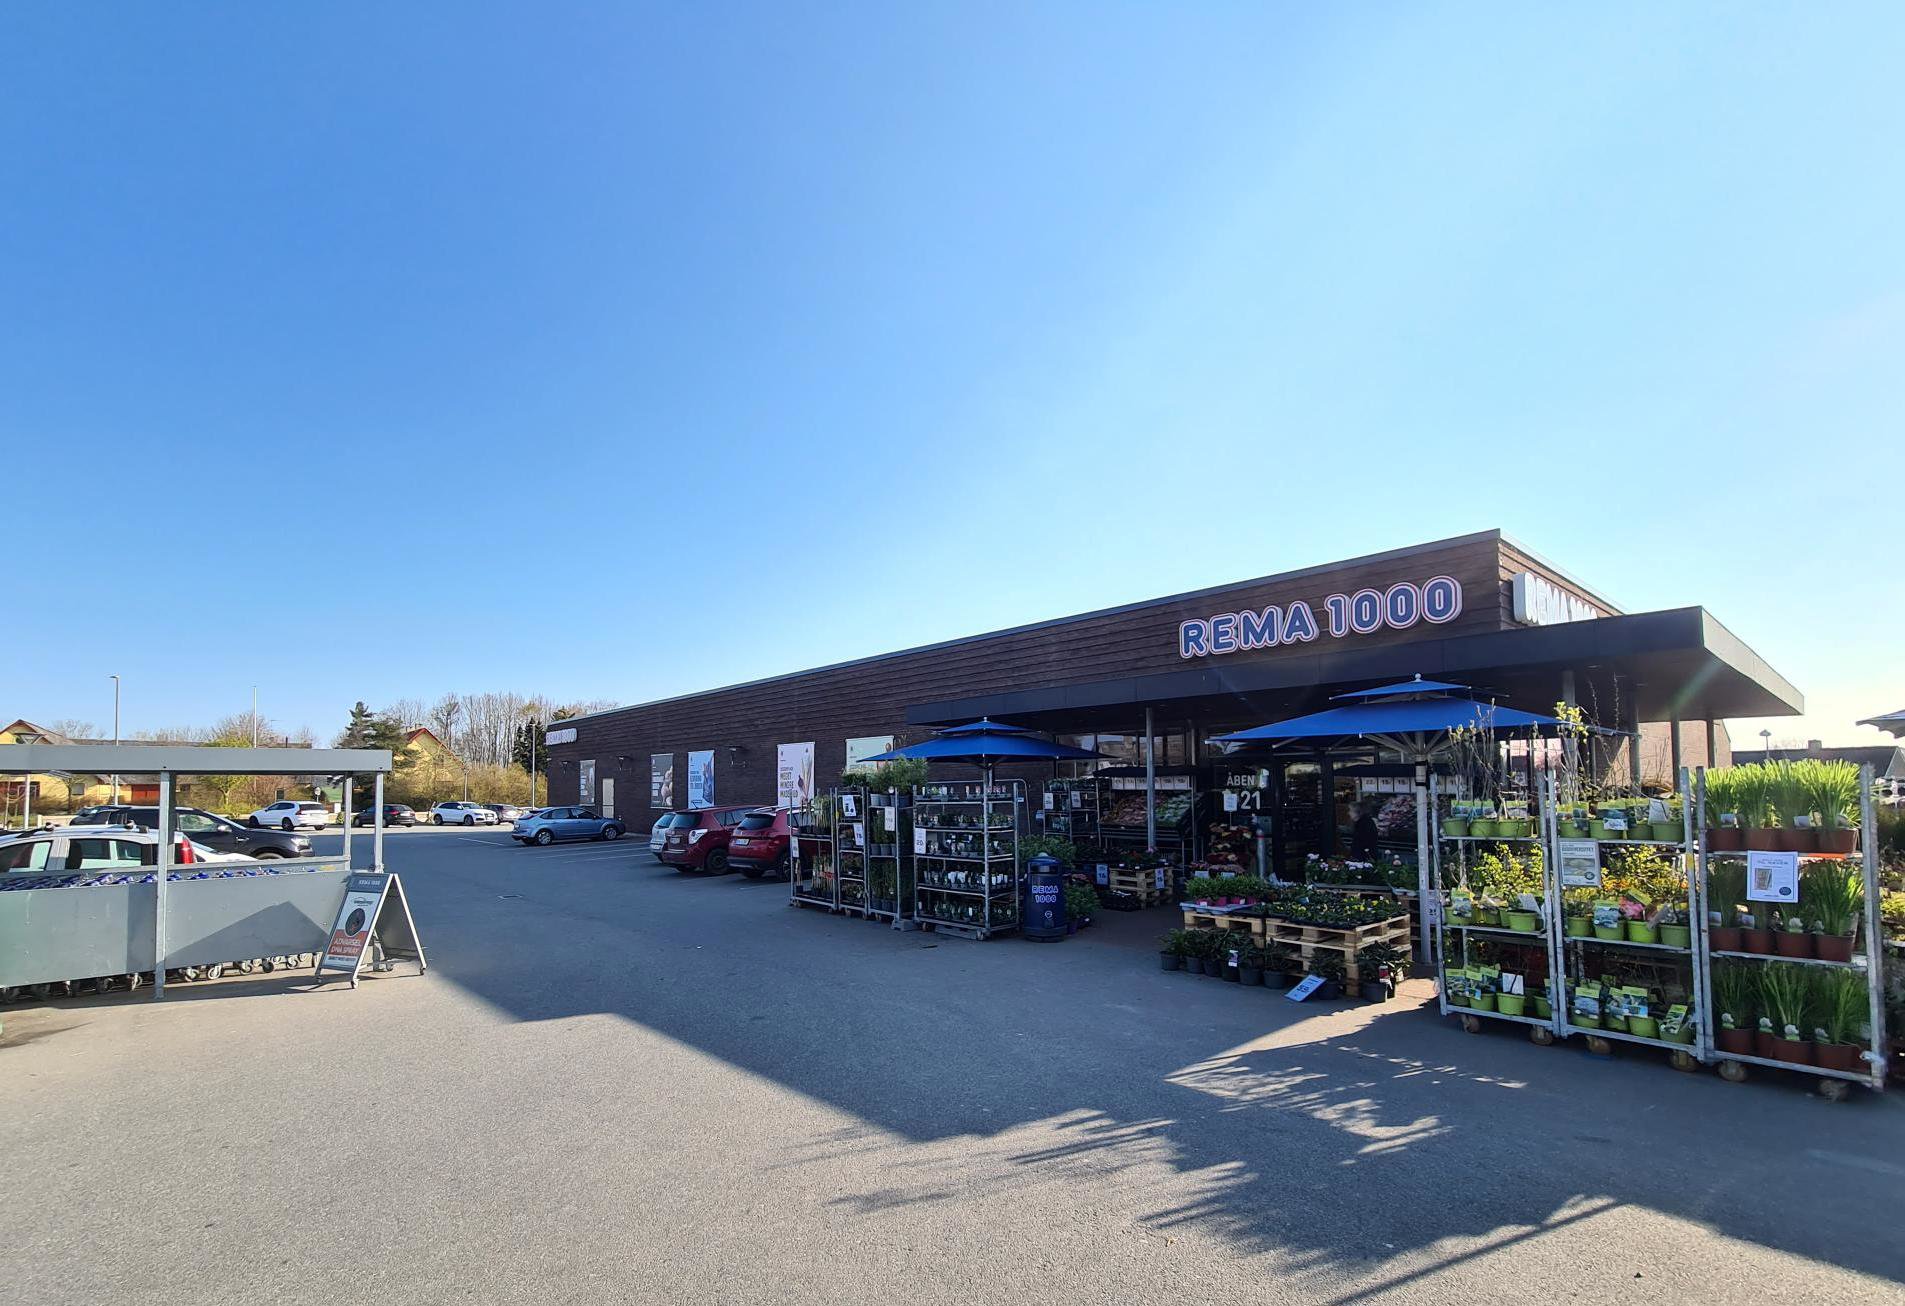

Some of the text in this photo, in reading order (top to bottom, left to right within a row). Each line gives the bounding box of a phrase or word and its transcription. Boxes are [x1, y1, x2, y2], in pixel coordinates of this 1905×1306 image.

[1179, 575, 1462, 659] REMA 1000
[1227, 772, 1255, 786] ÅBEN
[1241, 791, 1260, 810] 21
[1032, 885, 1058, 893] REMA
[1035, 895, 1056, 903] 1000
